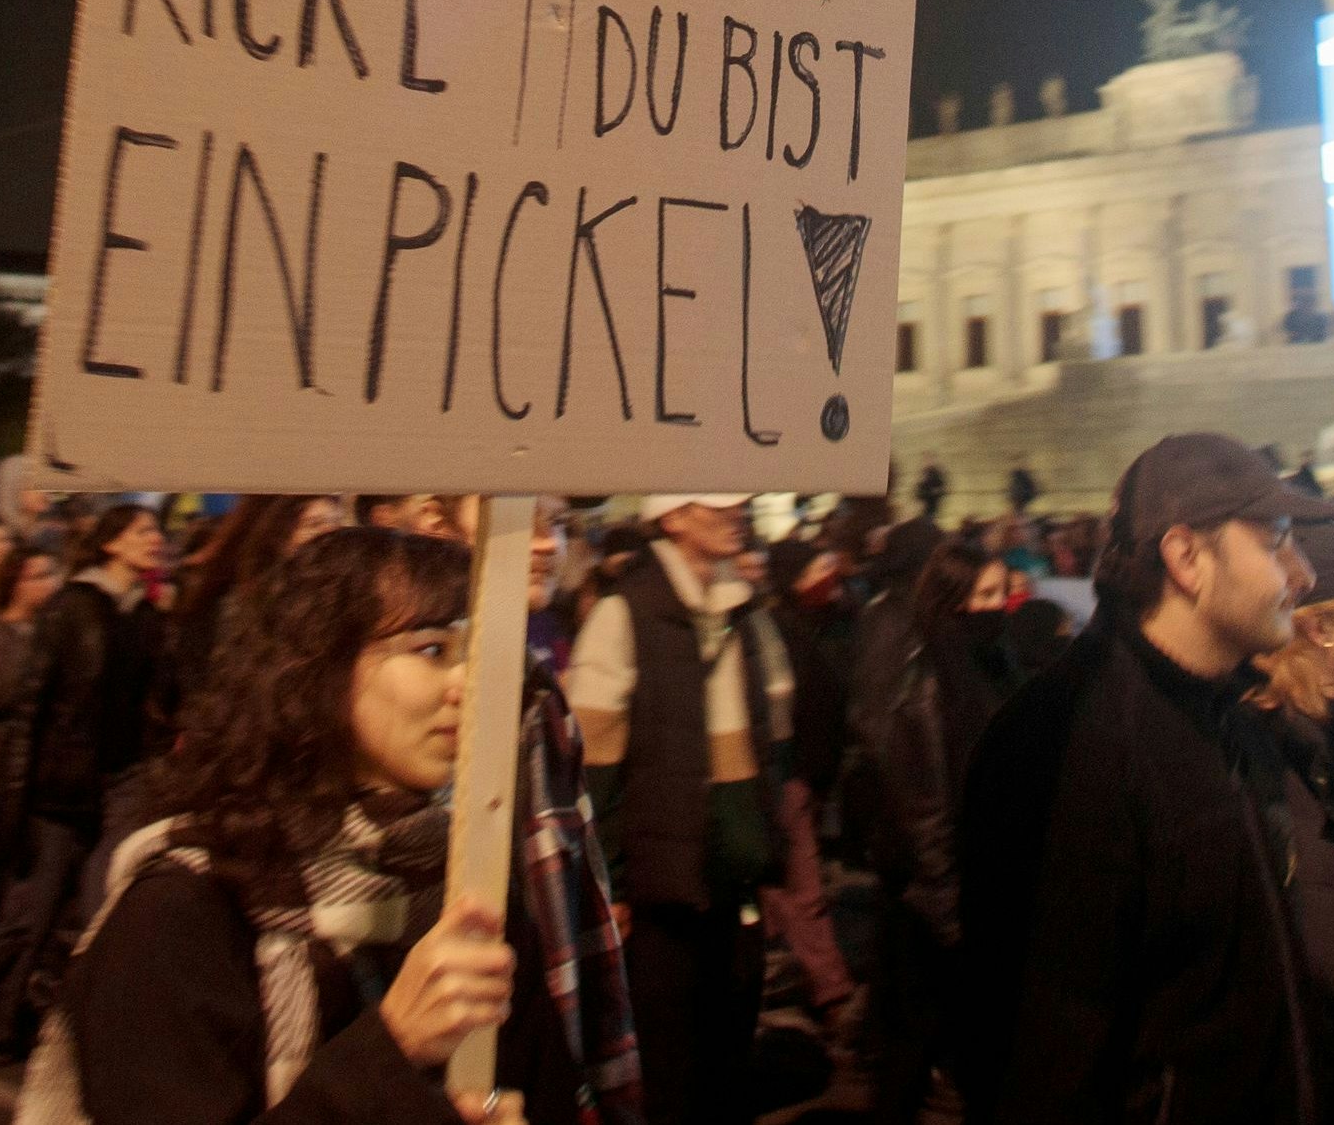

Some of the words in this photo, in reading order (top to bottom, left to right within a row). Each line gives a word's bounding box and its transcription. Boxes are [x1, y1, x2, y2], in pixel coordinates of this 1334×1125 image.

[594, 5, 688, 137] DU
[719, 16, 885, 183] BIST
[83, 126, 332, 395] EIN
[365, 161, 872, 446] PICKEL!
